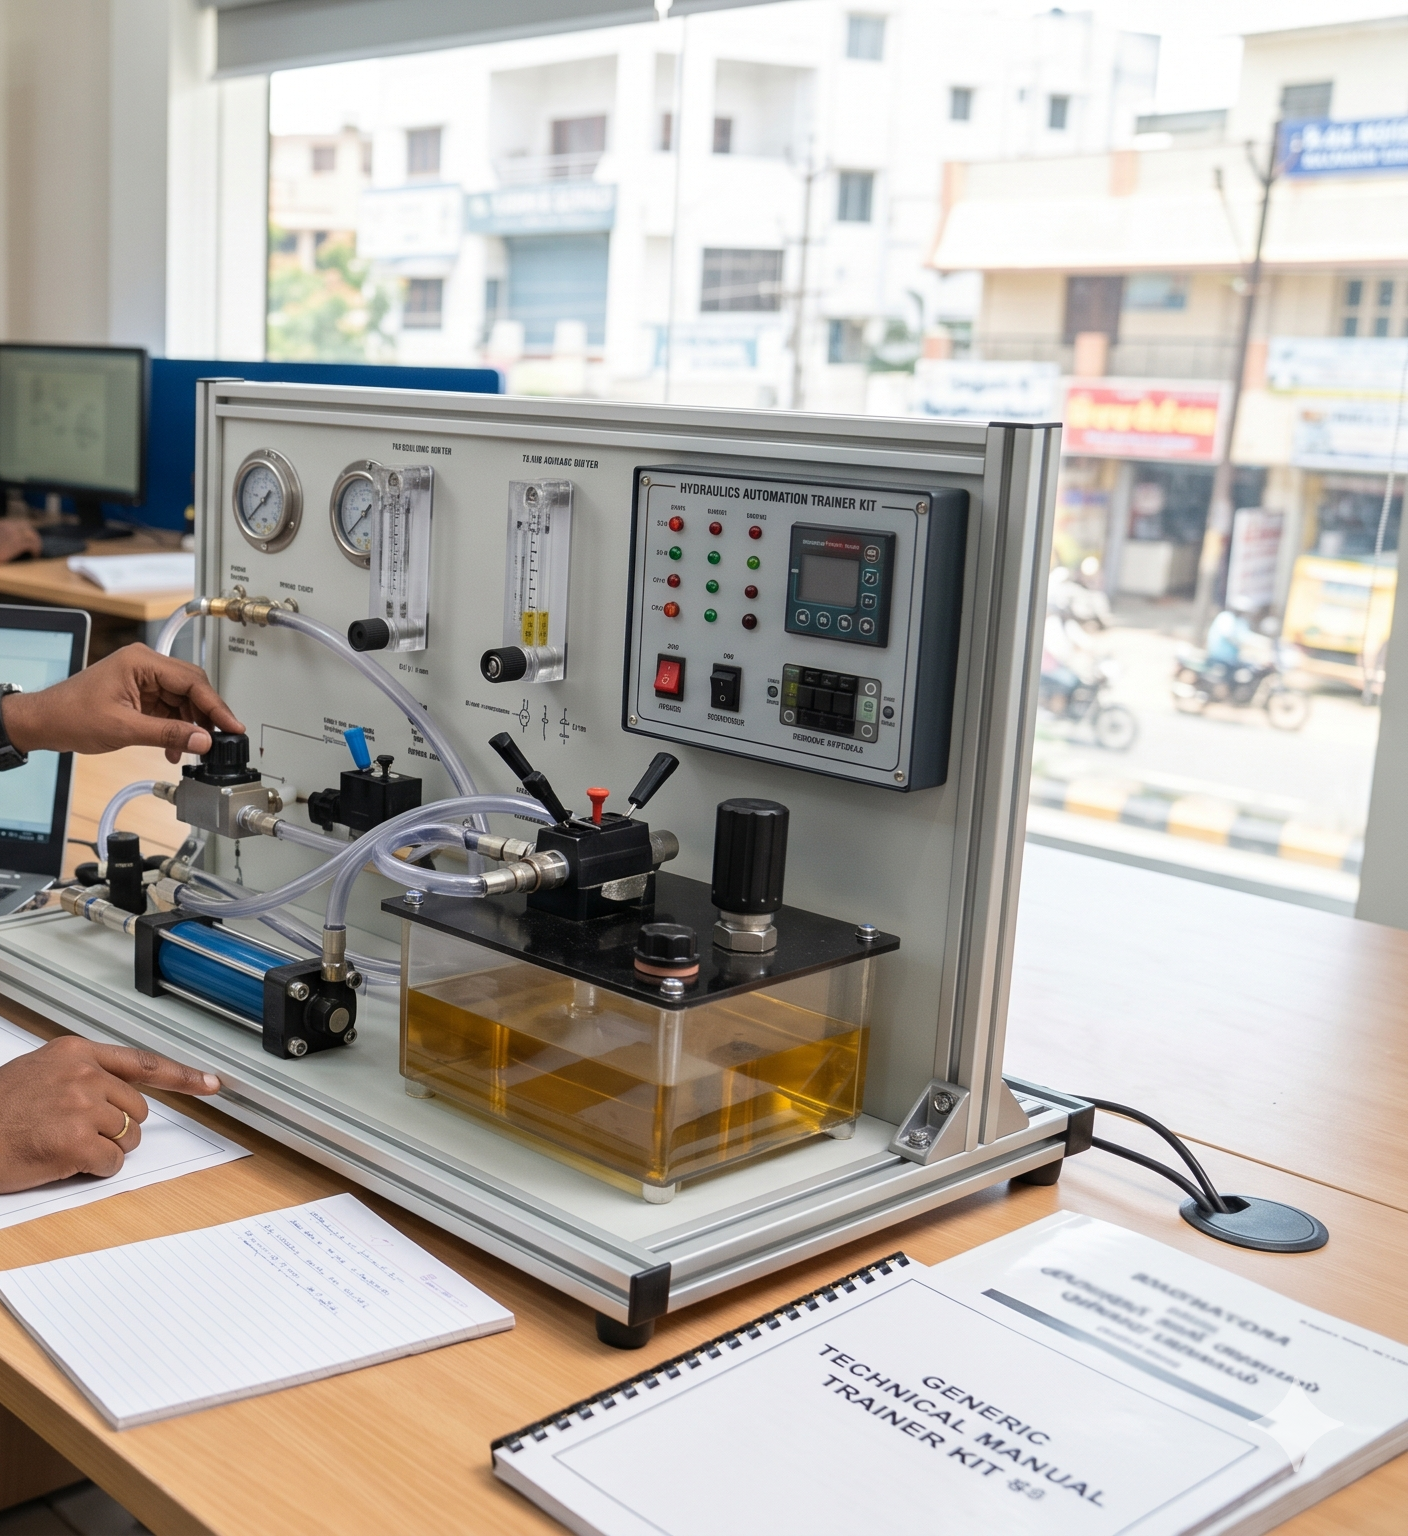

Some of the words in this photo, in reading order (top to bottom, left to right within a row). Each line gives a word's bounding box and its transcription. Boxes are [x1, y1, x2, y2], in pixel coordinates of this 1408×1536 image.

[680, 482, 740, 499] HYDRAULICS
[742, 488, 808, 505] AUTOMATION
[811, 494, 856, 510] TRAINER
[859, 499, 878, 512] KIT
[818, 1343, 965, 1434] TECHNICAL
[974, 1432, 1104, 1507] MANUAL
[822, 1373, 946, 1449] TRAINER
[947, 1446, 1004, 1477] KIT
[921, 1375, 1051, 1446] GENERIC
